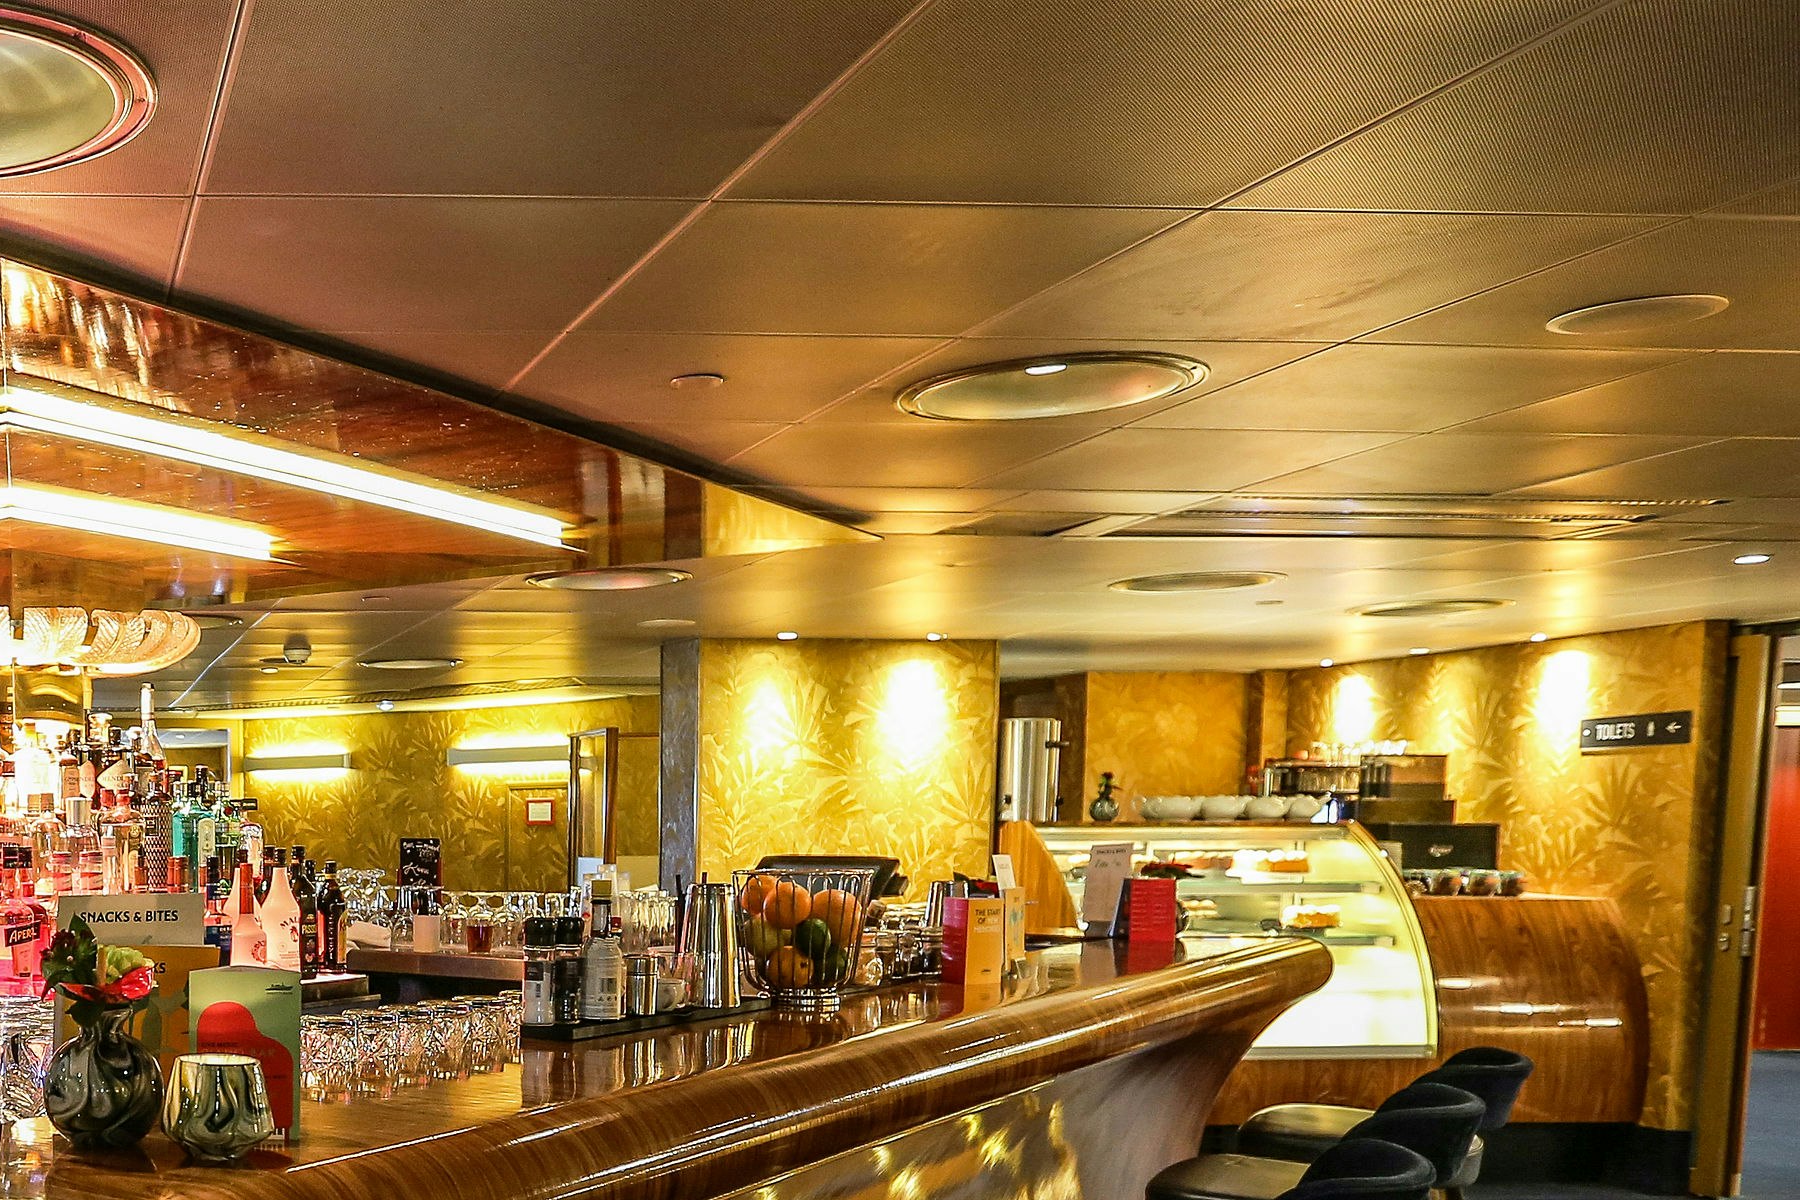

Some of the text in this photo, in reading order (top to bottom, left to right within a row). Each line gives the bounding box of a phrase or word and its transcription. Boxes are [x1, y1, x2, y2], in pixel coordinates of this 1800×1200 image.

[1595, 723, 1635, 740] TOILETS
[80, 910, 179, 923] SNACKS & BITES
